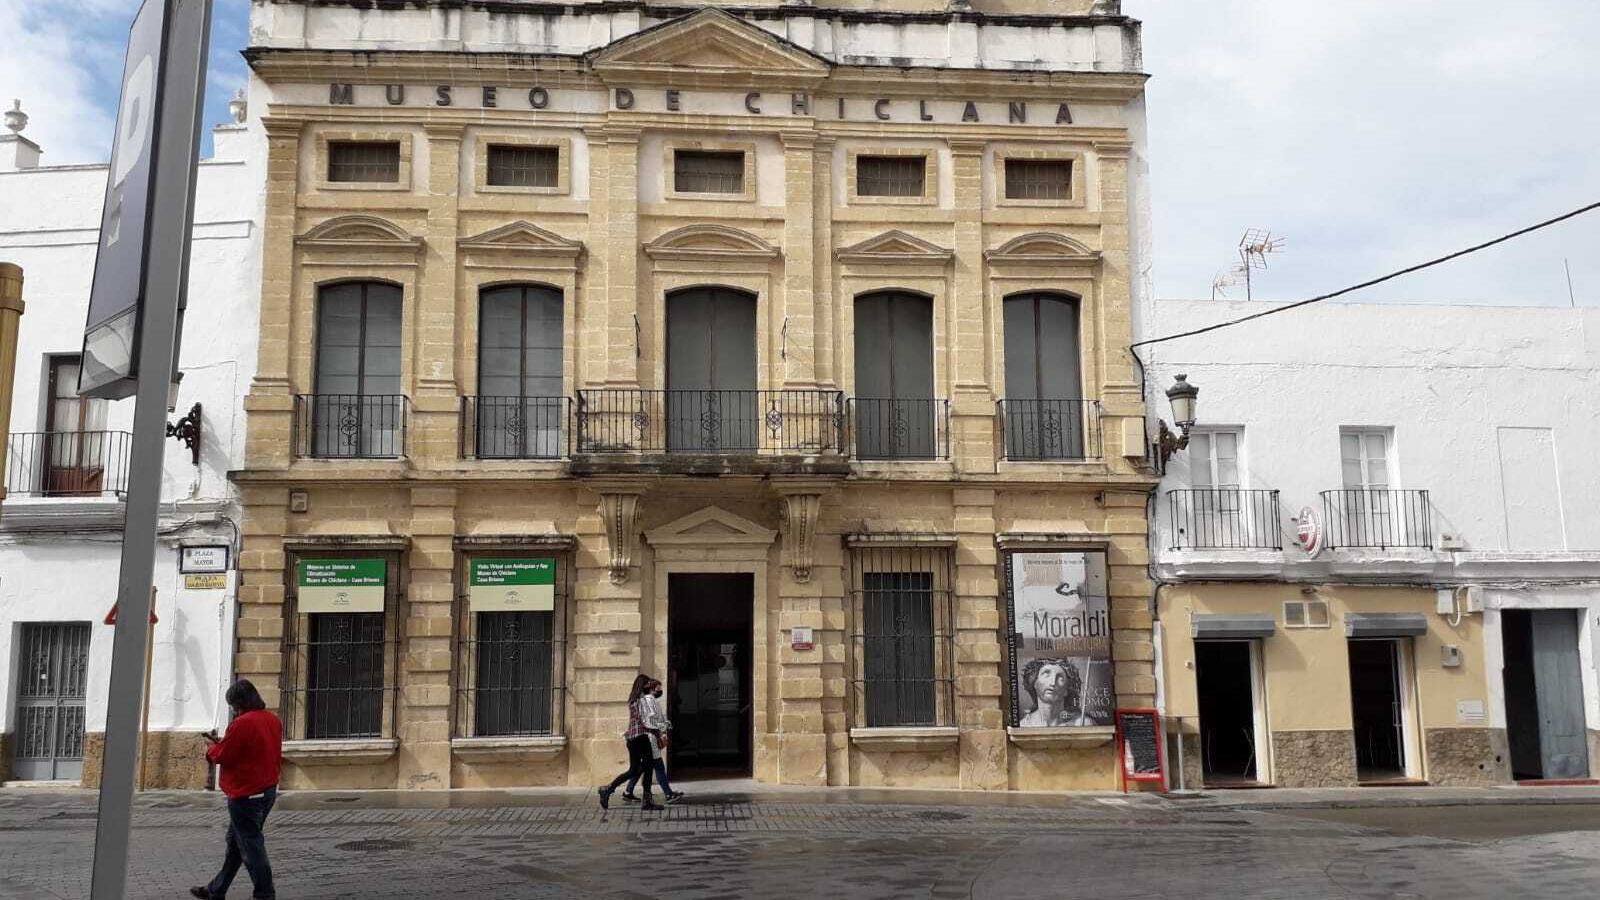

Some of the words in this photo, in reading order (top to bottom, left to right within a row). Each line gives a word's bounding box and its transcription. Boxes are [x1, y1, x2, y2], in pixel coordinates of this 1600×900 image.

[329, 83, 549, 110] MUSEO
[615, 87, 681, 112] DE
[744, 92, 1074, 125] CHICLANA
[1033, 610, 1106, 638] Moraldi
[1035, 637, 1053, 651] UNA
